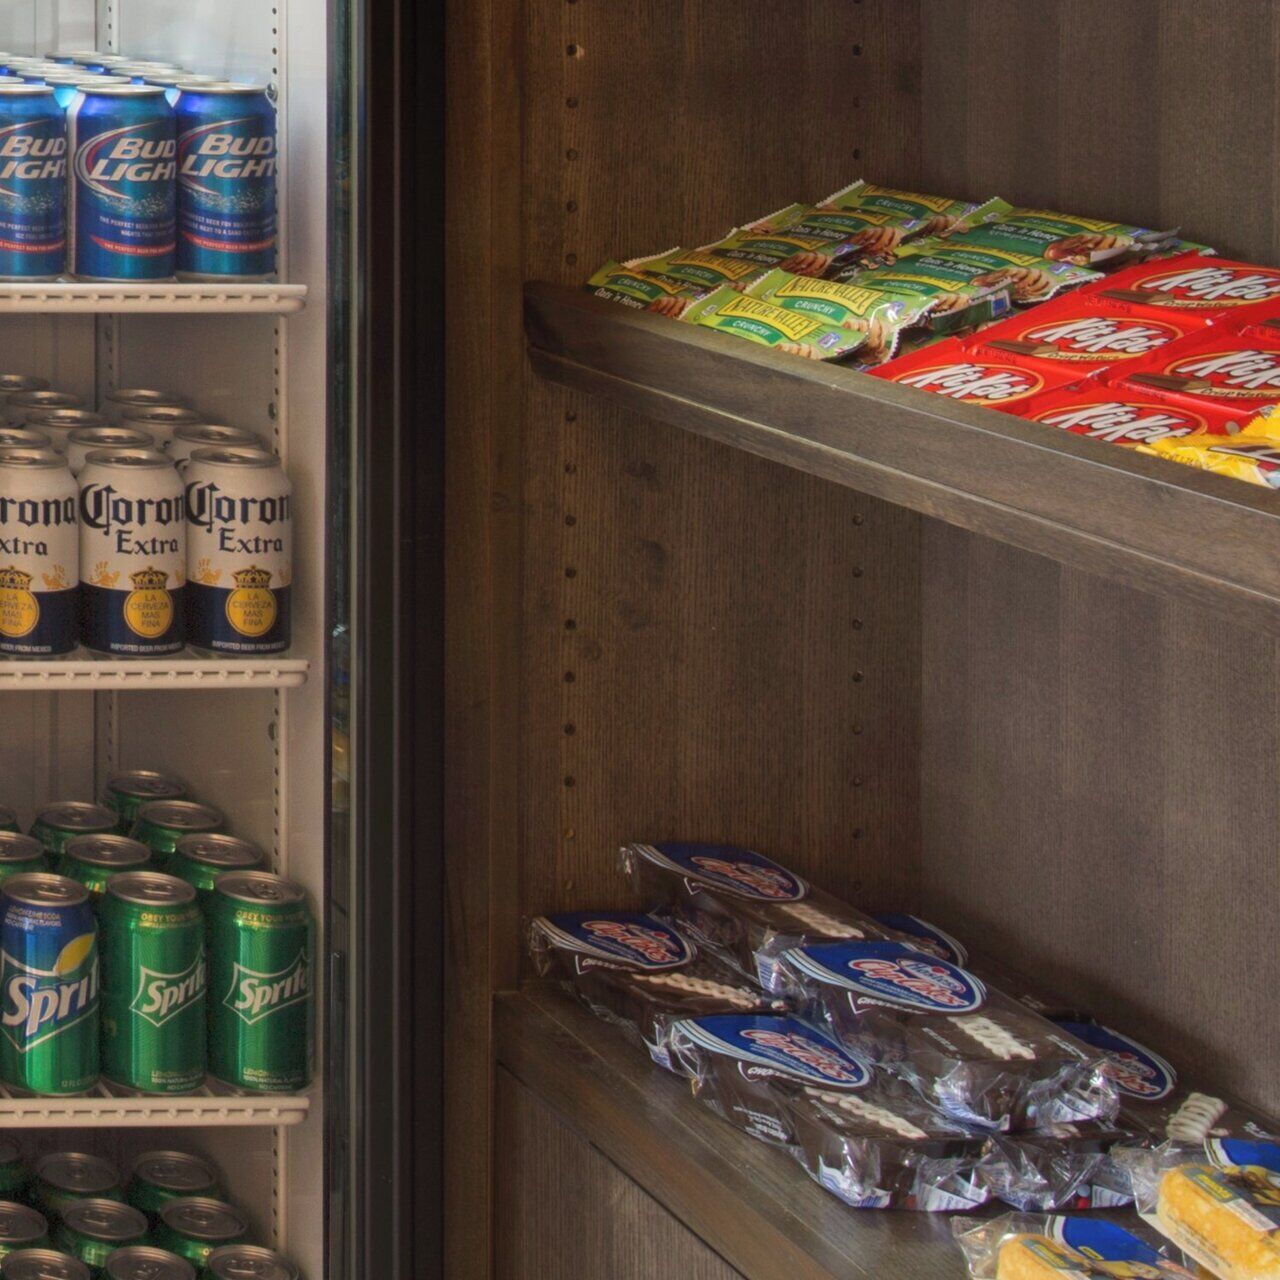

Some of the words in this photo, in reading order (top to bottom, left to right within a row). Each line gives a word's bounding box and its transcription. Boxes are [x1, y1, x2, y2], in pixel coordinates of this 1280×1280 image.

[0, 135, 65, 157] BUD
[109, 137, 176, 160] BUD
[198, 133, 274, 157] BUD
[594, 287, 612, 303] Oats
[790, 276, 831, 300] NATURE
[832, 283, 879, 310] VALLEY
[729, 297, 773, 324] NATURE
[771, 308, 819, 338] VALLEY
[794, 299, 837, 316] CRUNCHY
[732, 319, 771, 337] CRUNCHY
[80, 482, 186, 536] Coron
[186, 480, 291, 534] Coron
[116, 528, 179, 556] Extra
[218, 526, 283, 554] Extra
[130, 601, 170, 612] CERVEZA
[2, 960, 98, 1038] Sprit
